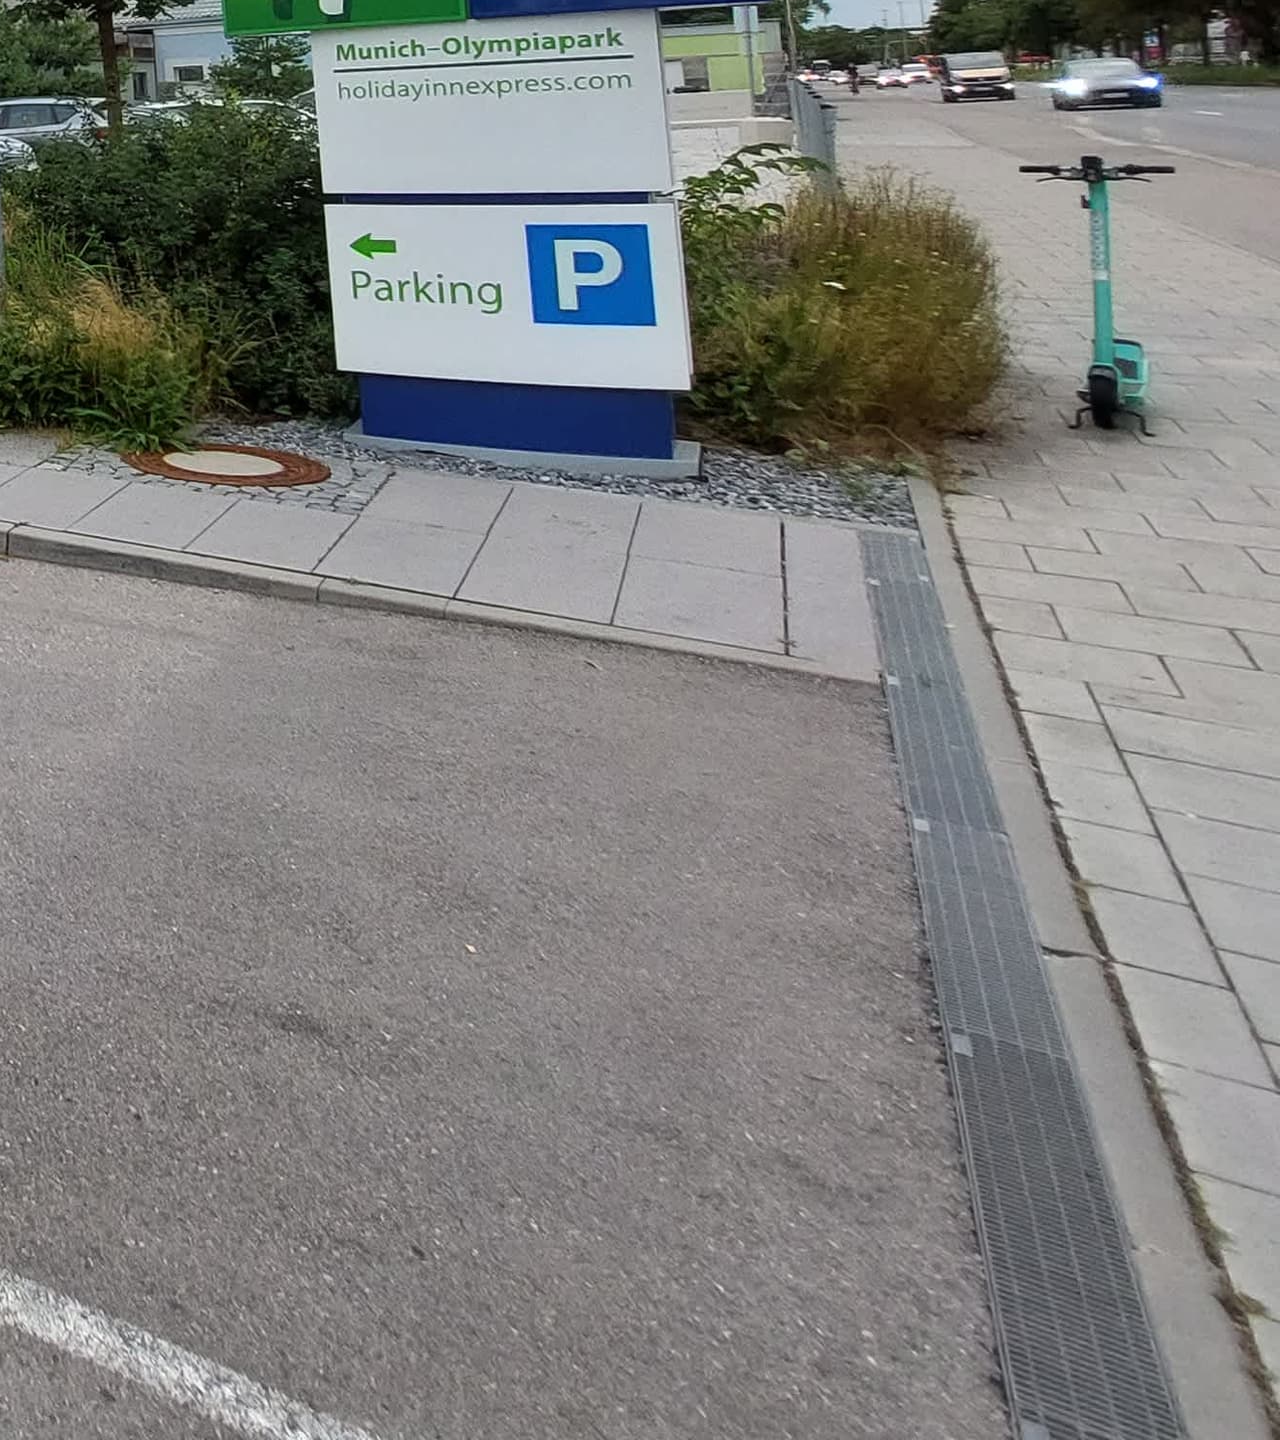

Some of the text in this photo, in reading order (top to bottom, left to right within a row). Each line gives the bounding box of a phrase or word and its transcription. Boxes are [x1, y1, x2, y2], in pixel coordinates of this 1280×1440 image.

[338, 73, 632, 102] holidayinnexpress.com
[350, 270, 503, 315] Parking
[553, 239, 624, 310] P
